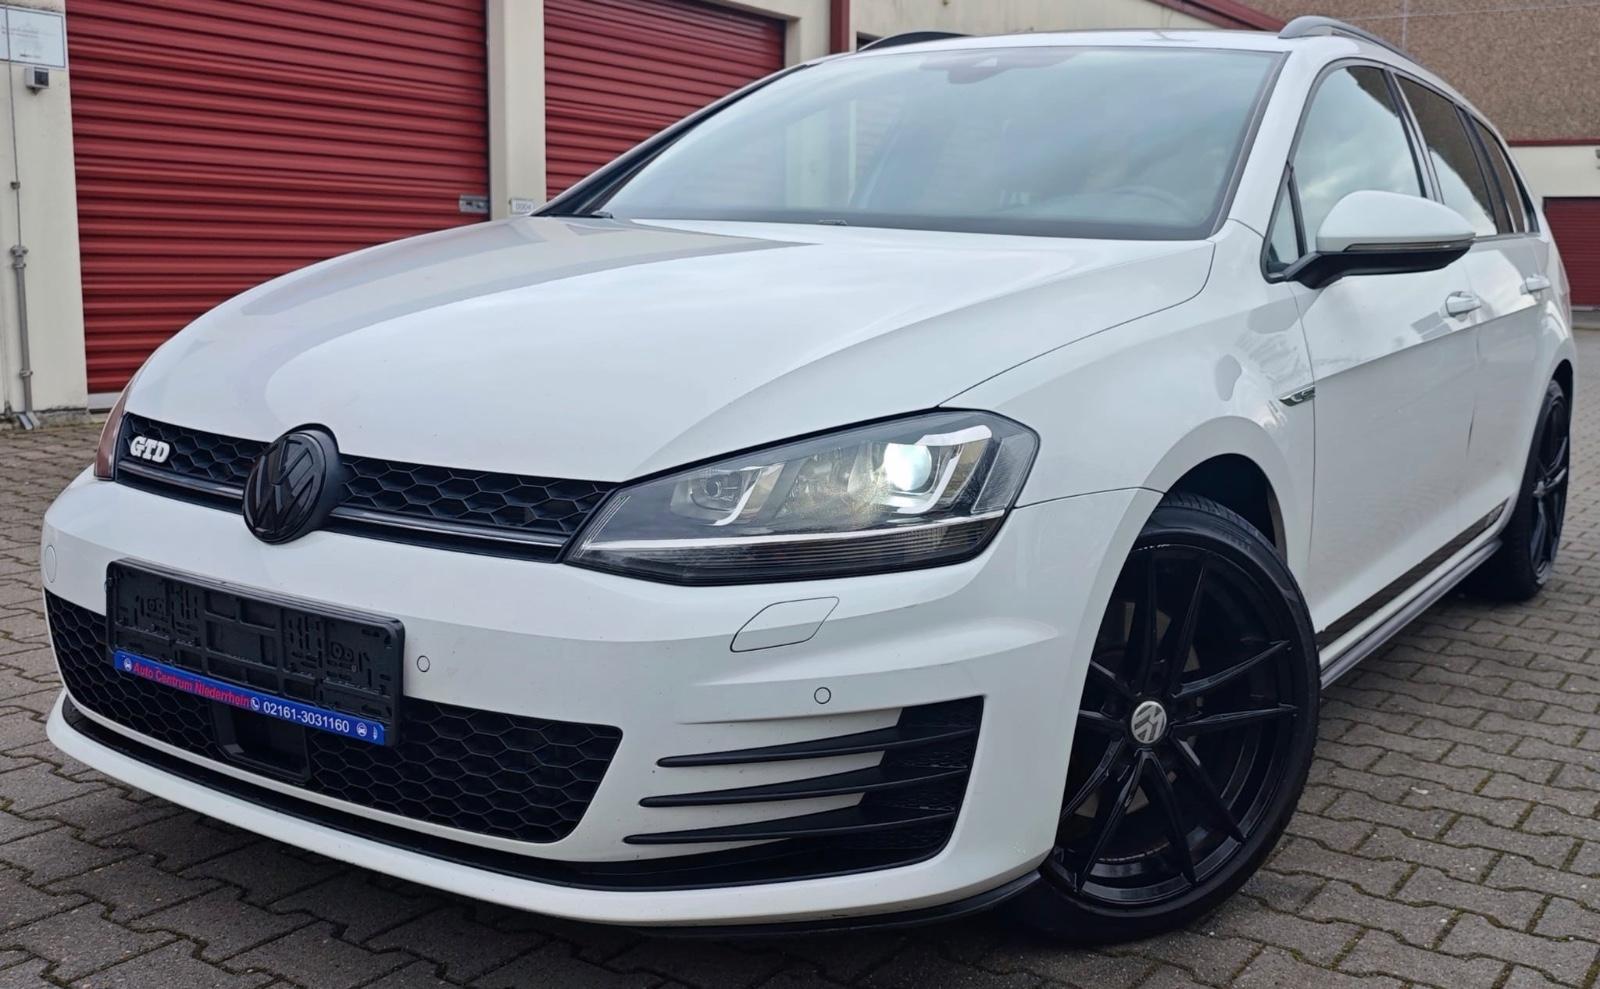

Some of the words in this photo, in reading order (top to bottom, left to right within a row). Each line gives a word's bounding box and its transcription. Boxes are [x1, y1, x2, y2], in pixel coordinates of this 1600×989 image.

[130, 435, 170, 463] GTD
[133, 662, 154, 680] Auto
[155, 670, 194, 692] Centrum
[195, 682, 251, 708] Niederrhein
[263, 701, 350, 733] 02161-3031160
